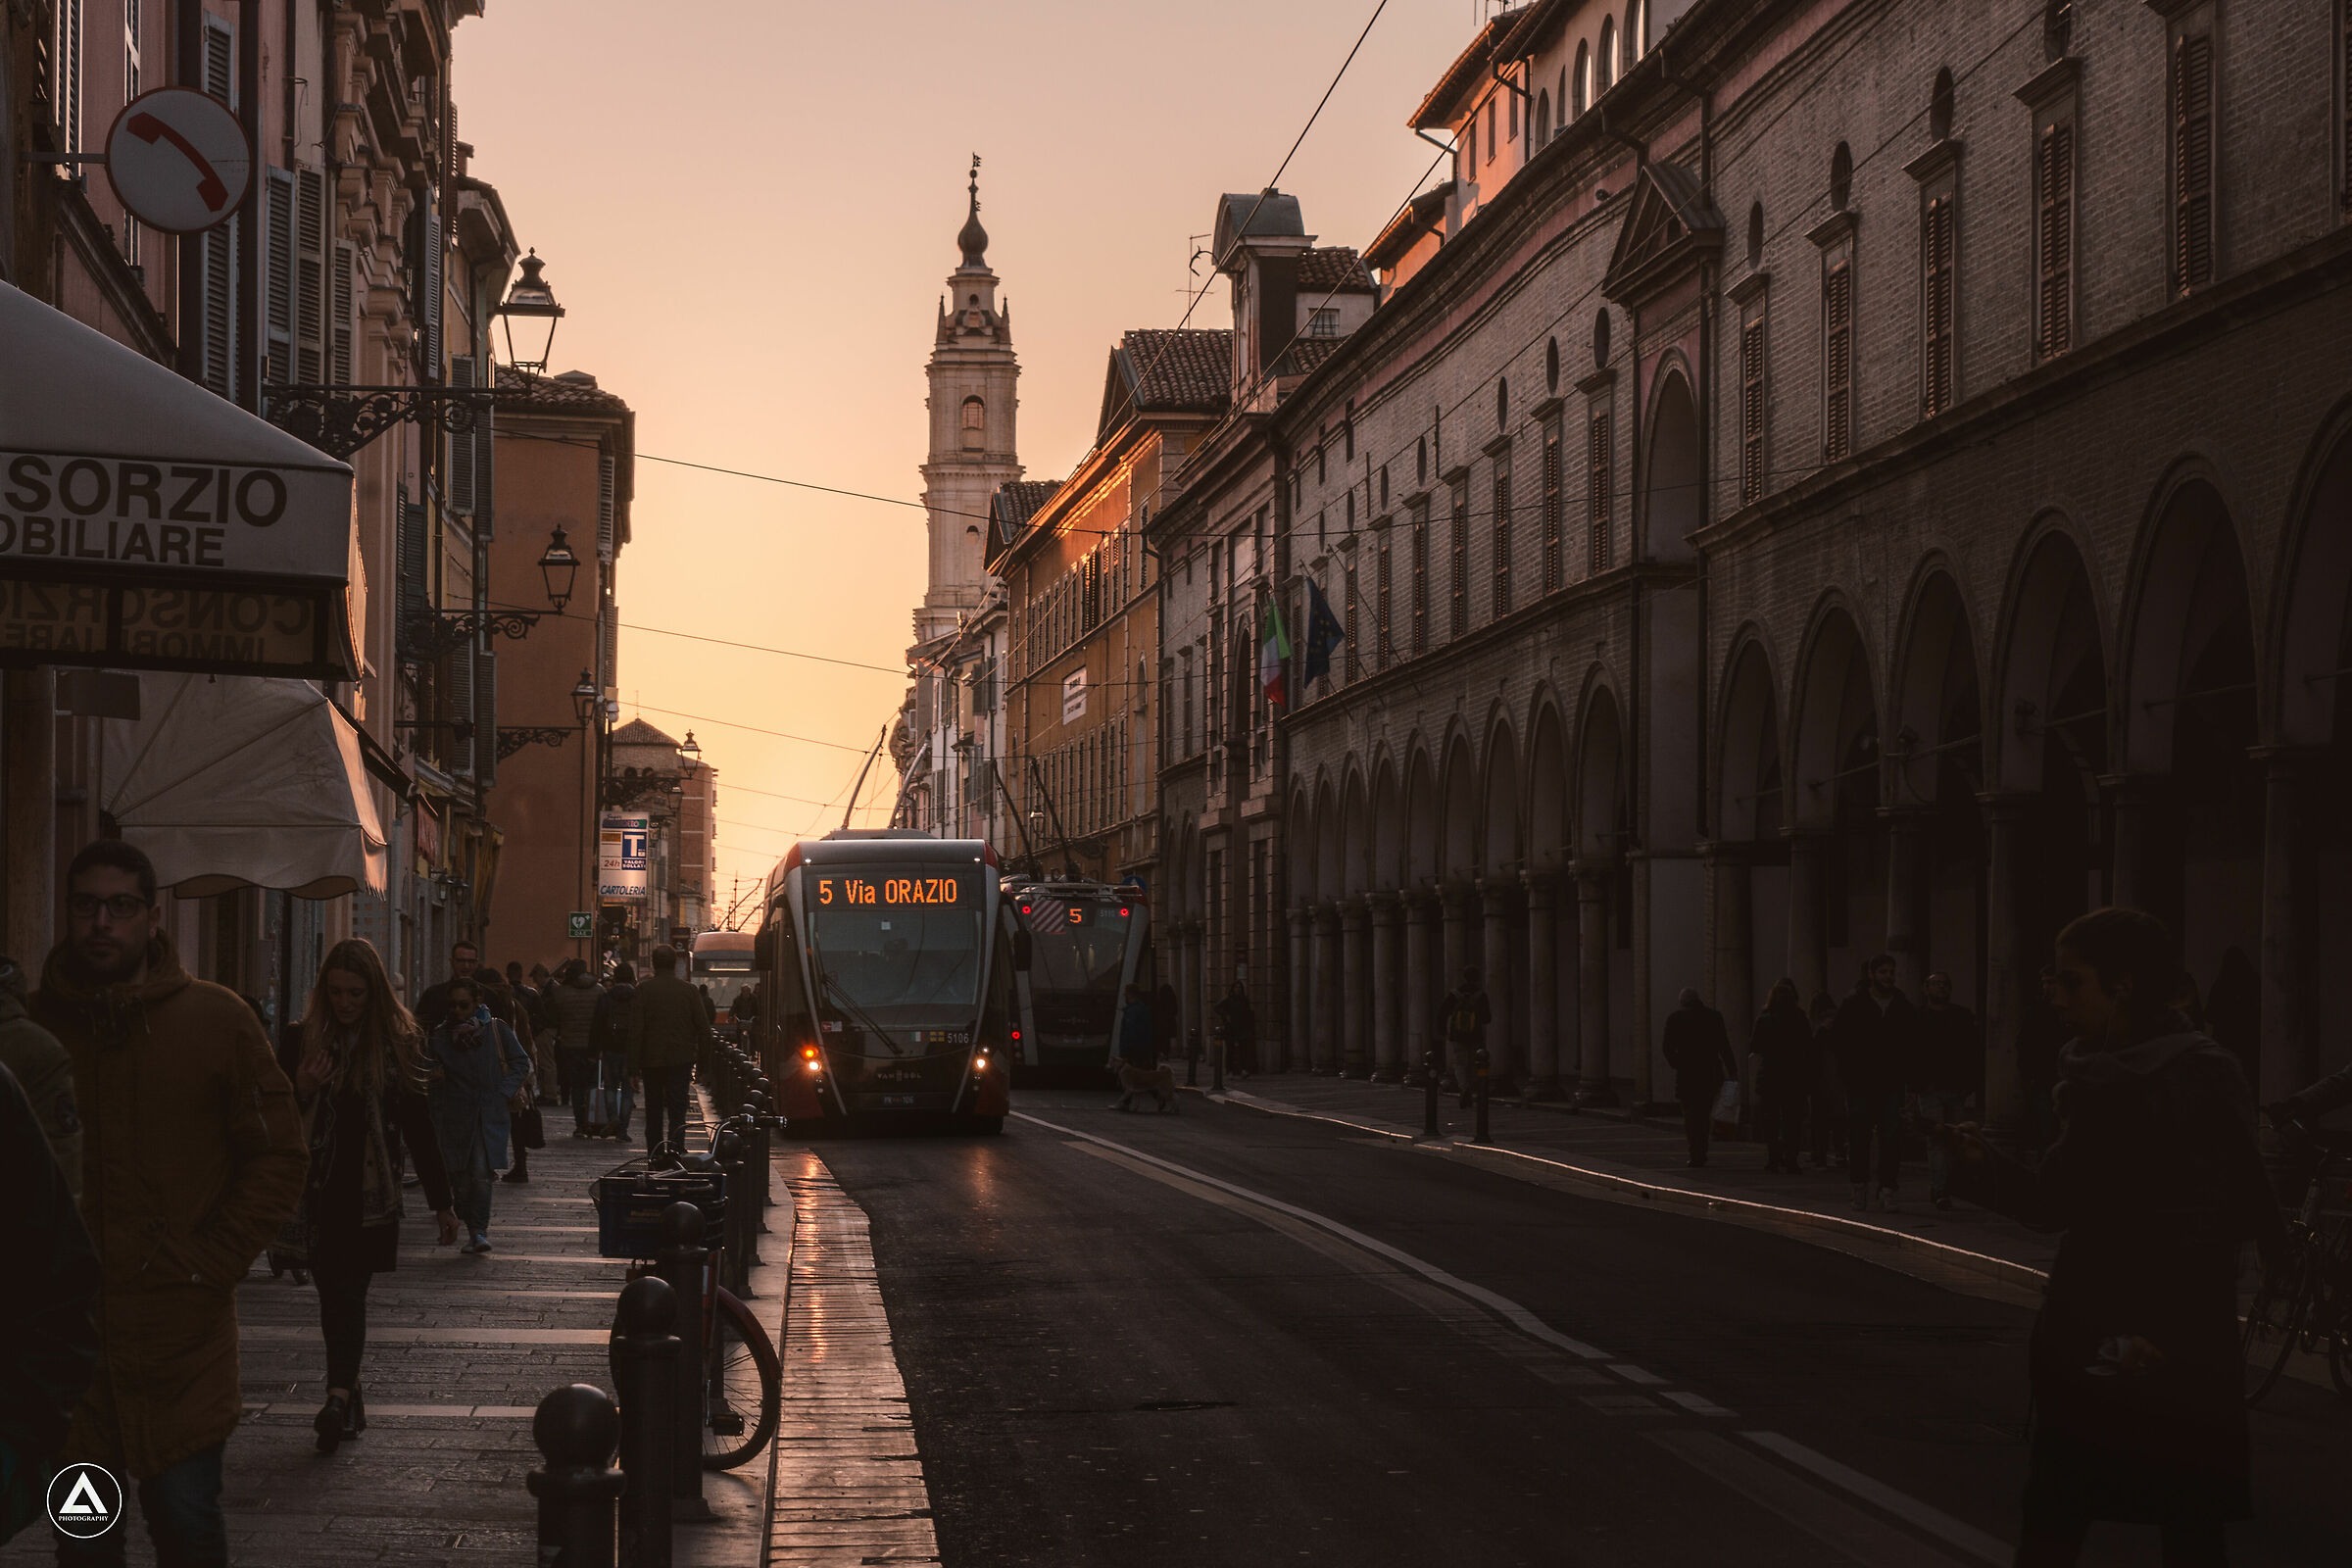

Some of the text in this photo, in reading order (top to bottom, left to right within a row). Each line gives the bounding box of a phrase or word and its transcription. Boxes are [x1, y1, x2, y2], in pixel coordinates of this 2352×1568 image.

[4, 455, 287, 527] SORZIO
[600, 885, 646, 896] CARTOLERIA
[819, 879, 957, 904] 5 Via ORAZIO
[1069, 908, 1083, 924] 5
[947, 1033, 969, 1044] 5106
